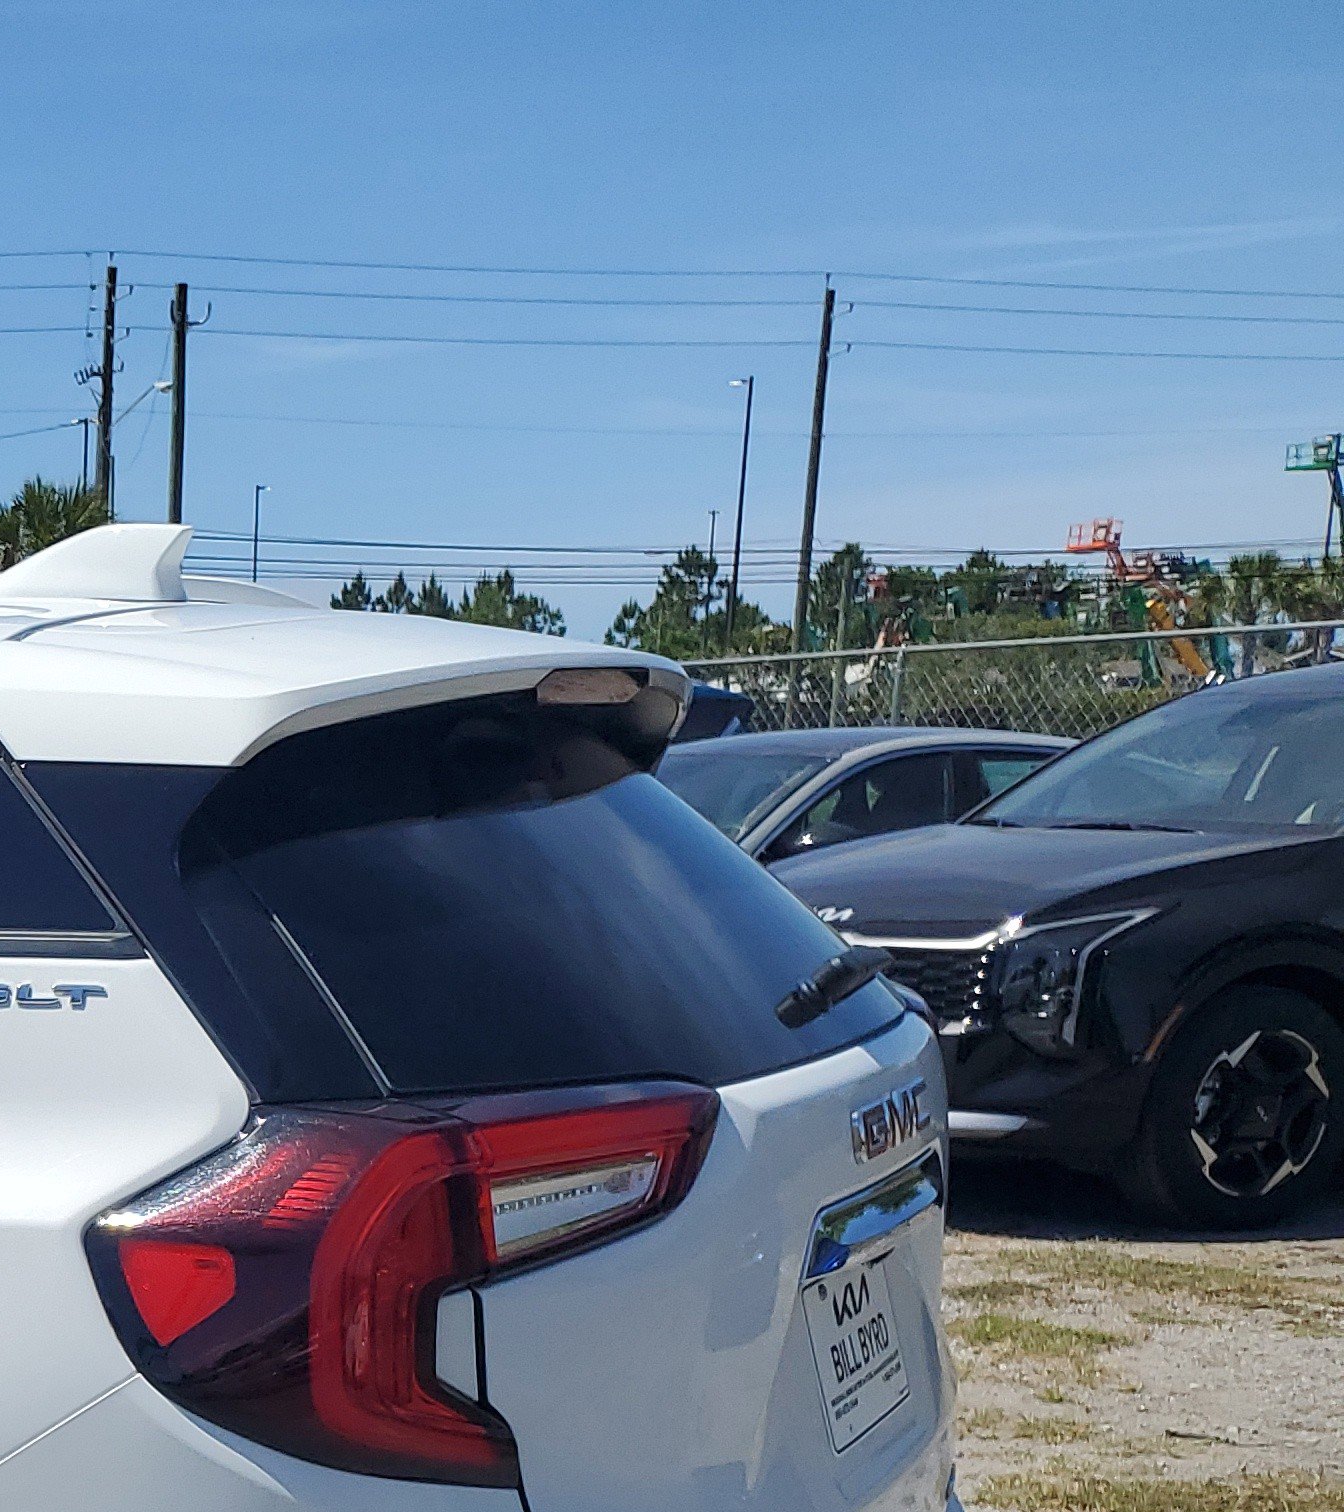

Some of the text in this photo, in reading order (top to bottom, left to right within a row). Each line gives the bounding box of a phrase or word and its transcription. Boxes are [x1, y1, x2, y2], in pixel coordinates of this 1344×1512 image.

[850, 1075, 931, 1164] GMC
[832, 1272, 870, 1327] KIA
[830, 1334, 862, 1383] BILL
[857, 1311, 889, 1365] BYRD
